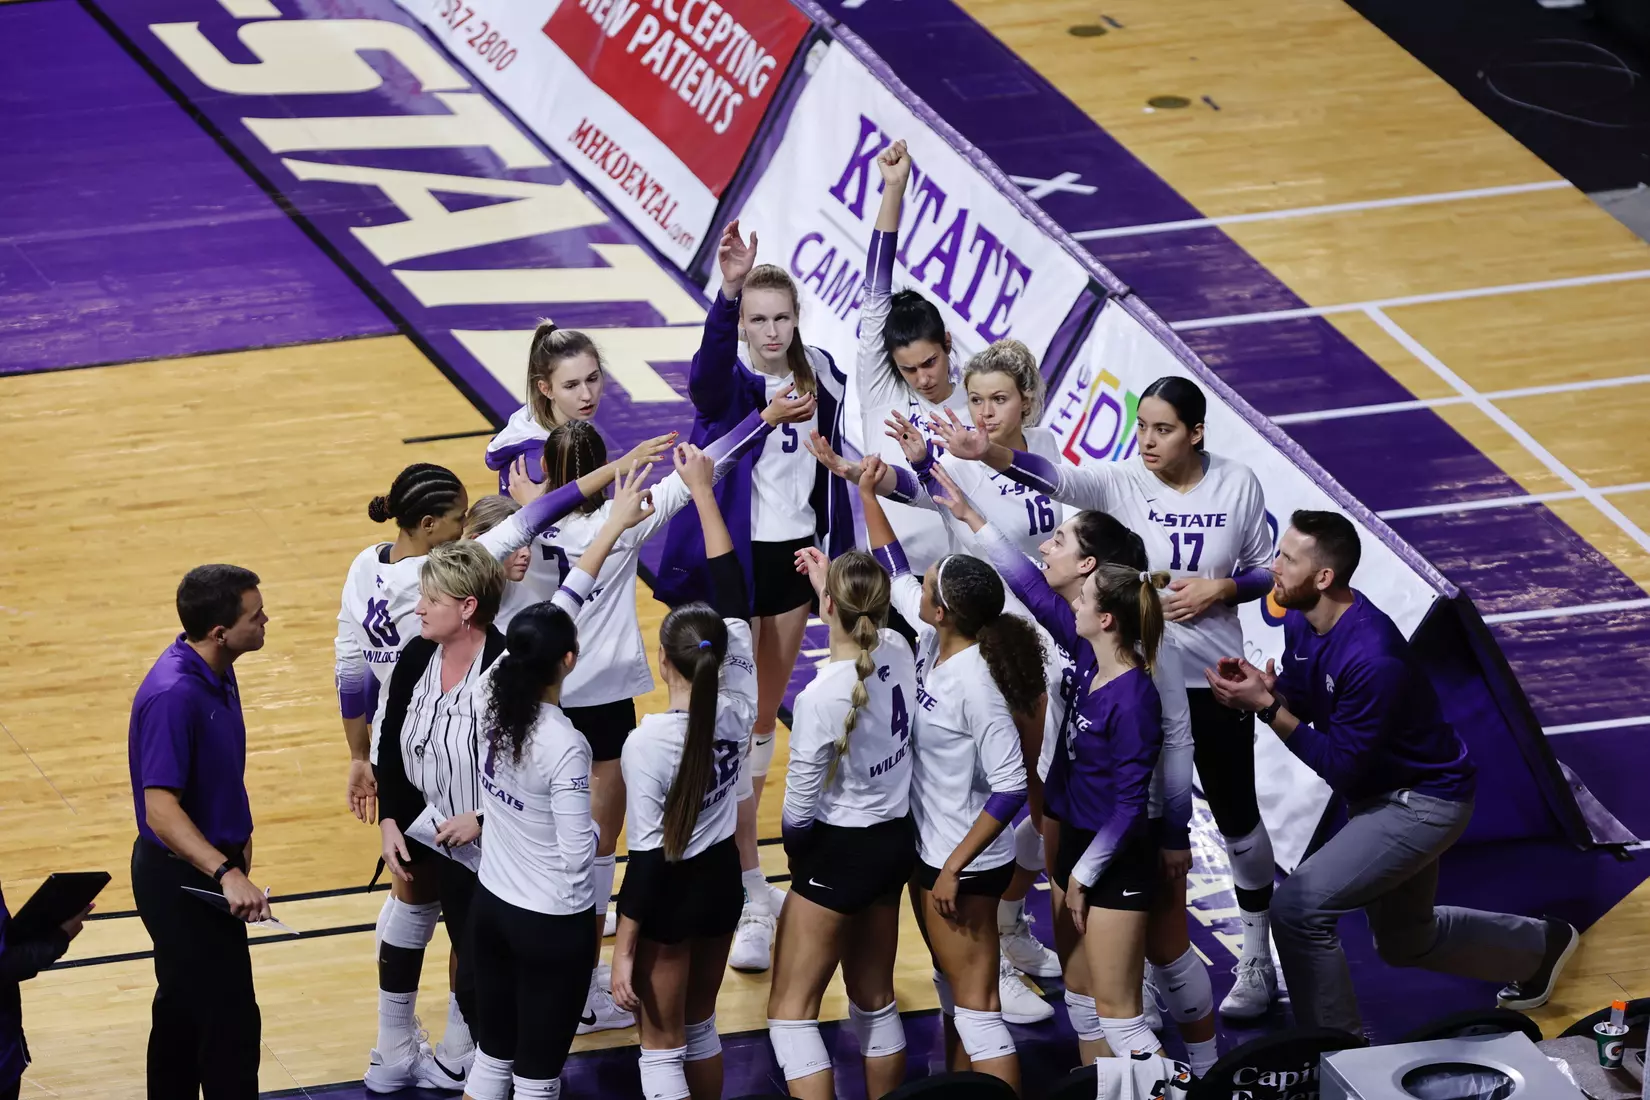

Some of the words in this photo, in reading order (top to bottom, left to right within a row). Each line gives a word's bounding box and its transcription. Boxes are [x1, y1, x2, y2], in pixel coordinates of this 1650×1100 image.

[650, 0, 777, 98] CCEPTING
[626, 13, 744, 135] PATIENTS
[1024, 494, 1055, 536] 16
[1148, 508, 1227, 528] K-STATE
[541, 543, 571, 588] 7
[1169, 532, 1205, 572] 17
[891, 683, 910, 742] 4
[869, 741, 911, 778] WILDC
[481, 774, 525, 811] DCATS
